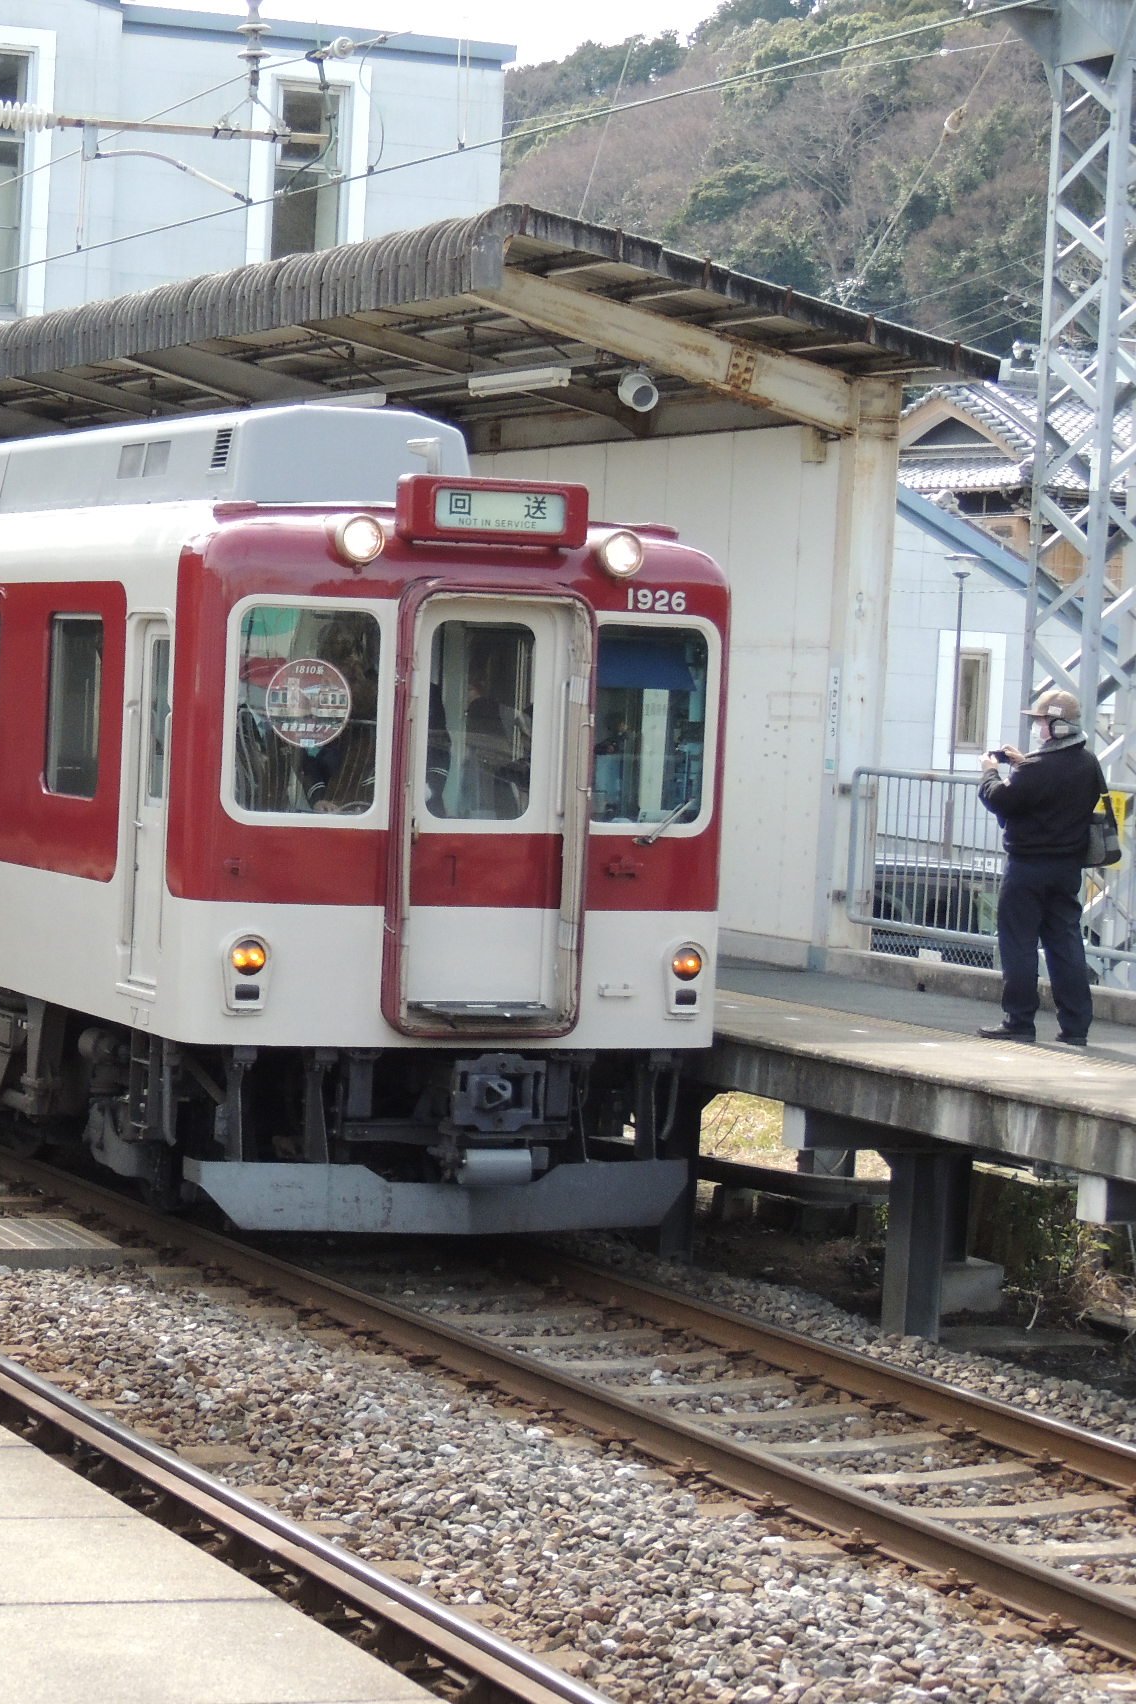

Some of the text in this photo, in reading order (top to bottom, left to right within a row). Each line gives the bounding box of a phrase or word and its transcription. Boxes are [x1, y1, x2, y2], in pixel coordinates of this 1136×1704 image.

[458, 517, 537, 530] NOT IN SERVICE
[627, 587, 687, 612] 1926
[294, 665, 325, 675] 1810系
